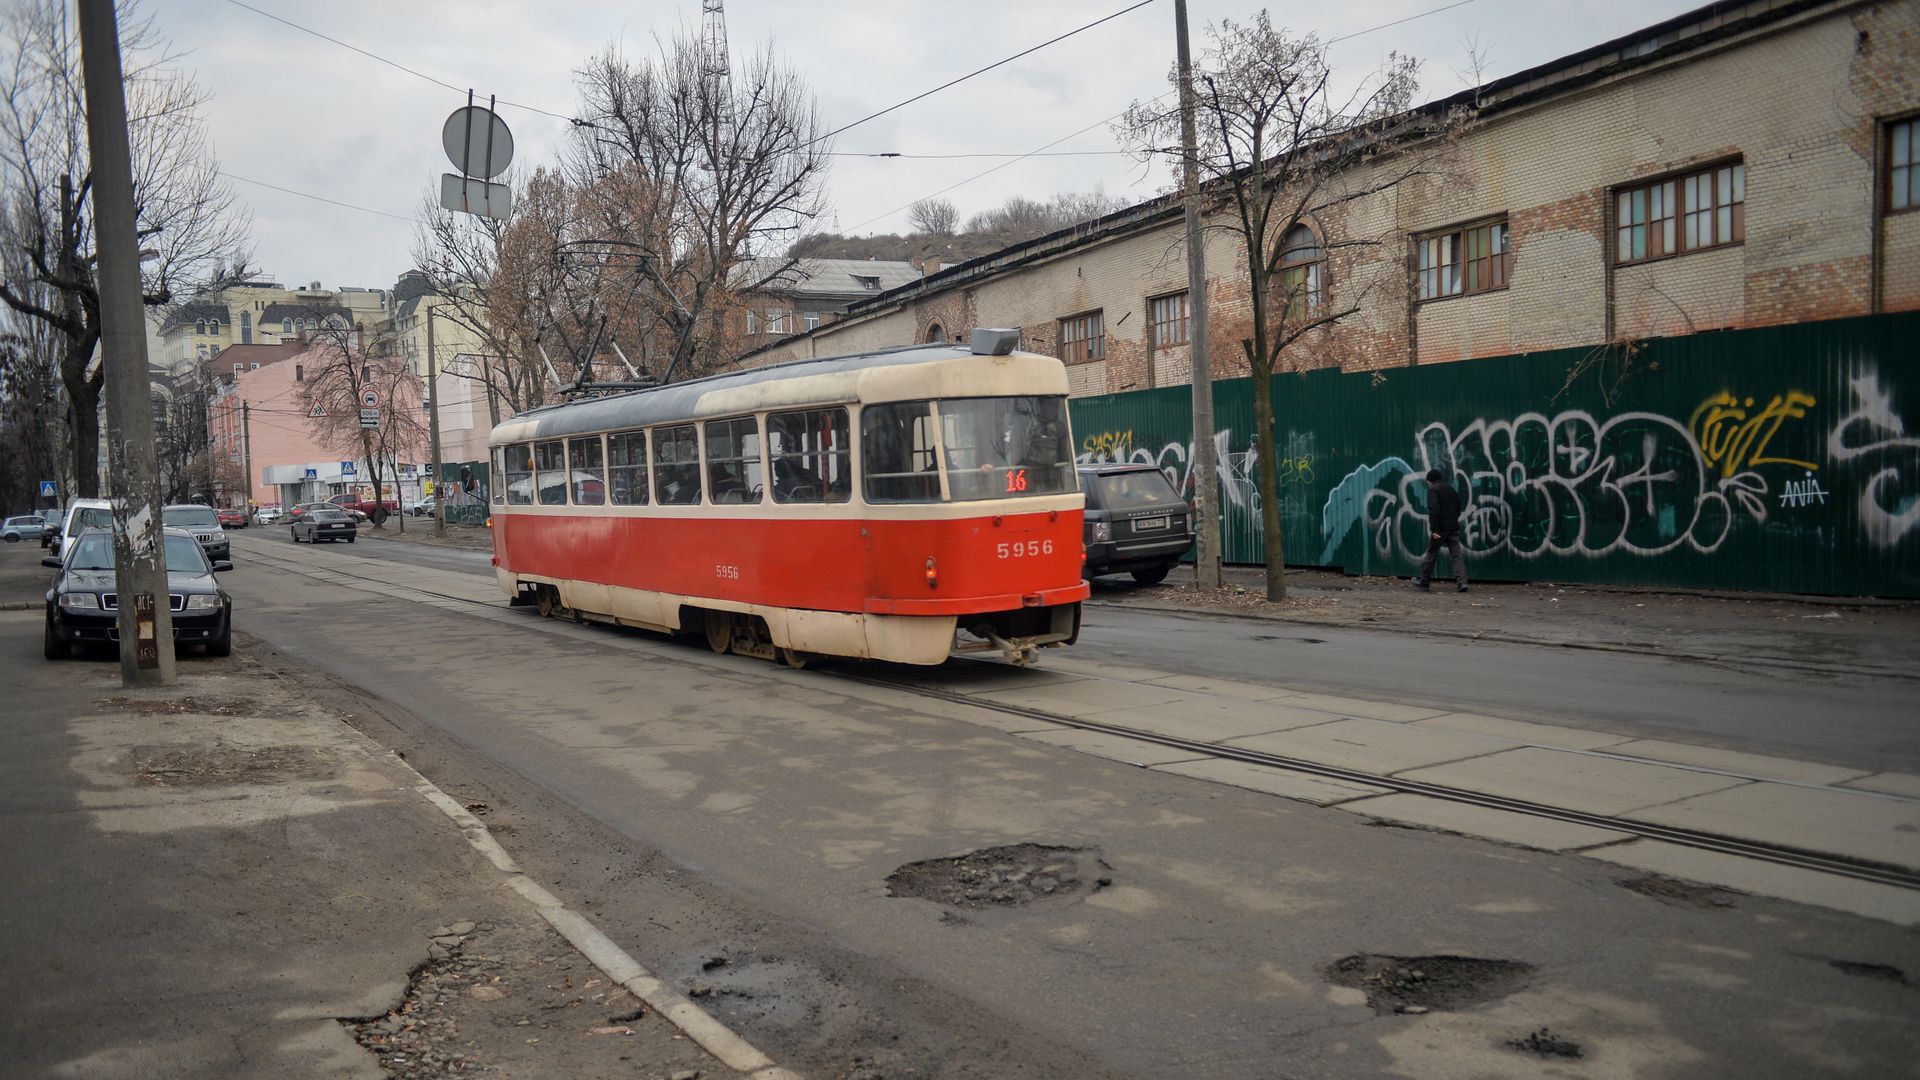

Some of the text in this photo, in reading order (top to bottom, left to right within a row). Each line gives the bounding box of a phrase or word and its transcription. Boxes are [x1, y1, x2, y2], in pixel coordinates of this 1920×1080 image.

[1006, 469, 1026, 492] 16
[997, 539, 1053, 559] 5956
[716, 565, 739, 579] 5956
